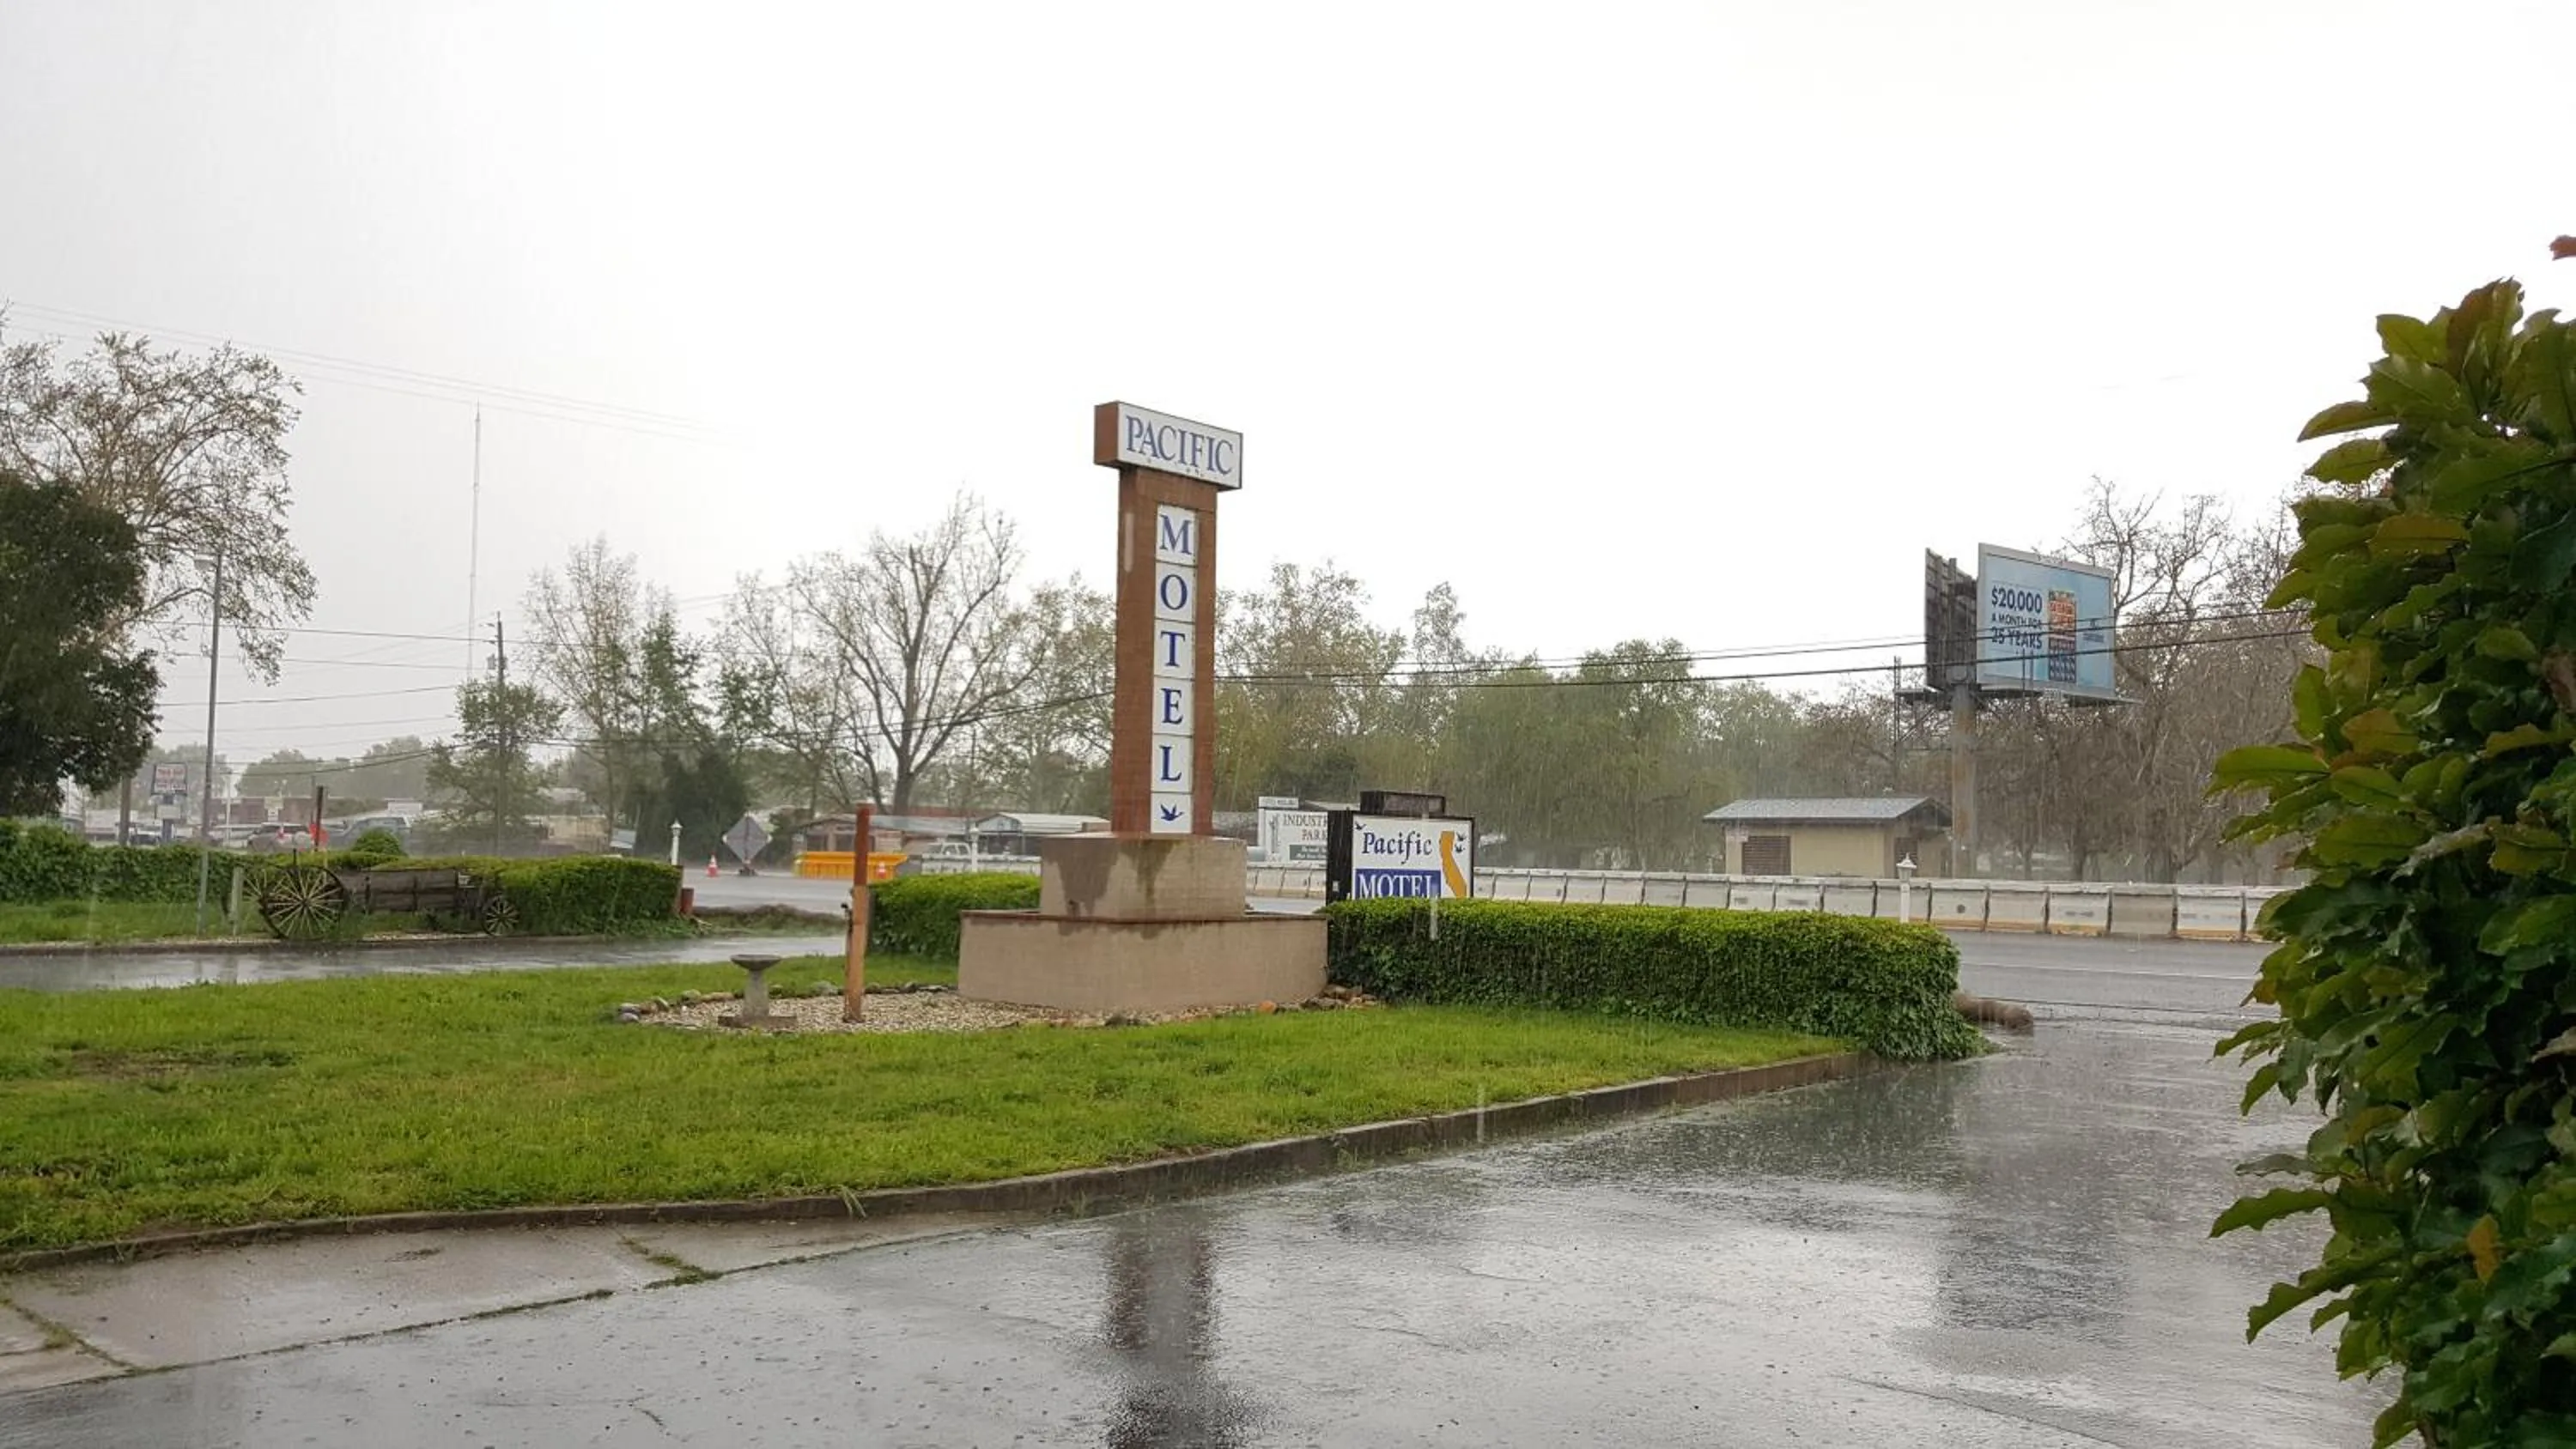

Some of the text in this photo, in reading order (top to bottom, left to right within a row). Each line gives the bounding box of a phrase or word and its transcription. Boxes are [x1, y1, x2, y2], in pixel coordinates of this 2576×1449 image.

[1126, 415, 1234, 475] PACIFIC
[1991, 585, 2043, 614] $20,000
[1991, 613, 1996, 622] A
[1998, 613, 2027, 627] MONTH
[1158, 514, 1193, 782] MOTEL
[1991, 626, 2005, 645] 25
[2008, 628, 2043, 650] YEARS
[1361, 830, 1433, 865] Pacific
[1358, 873, 1440, 900] MOTEL
